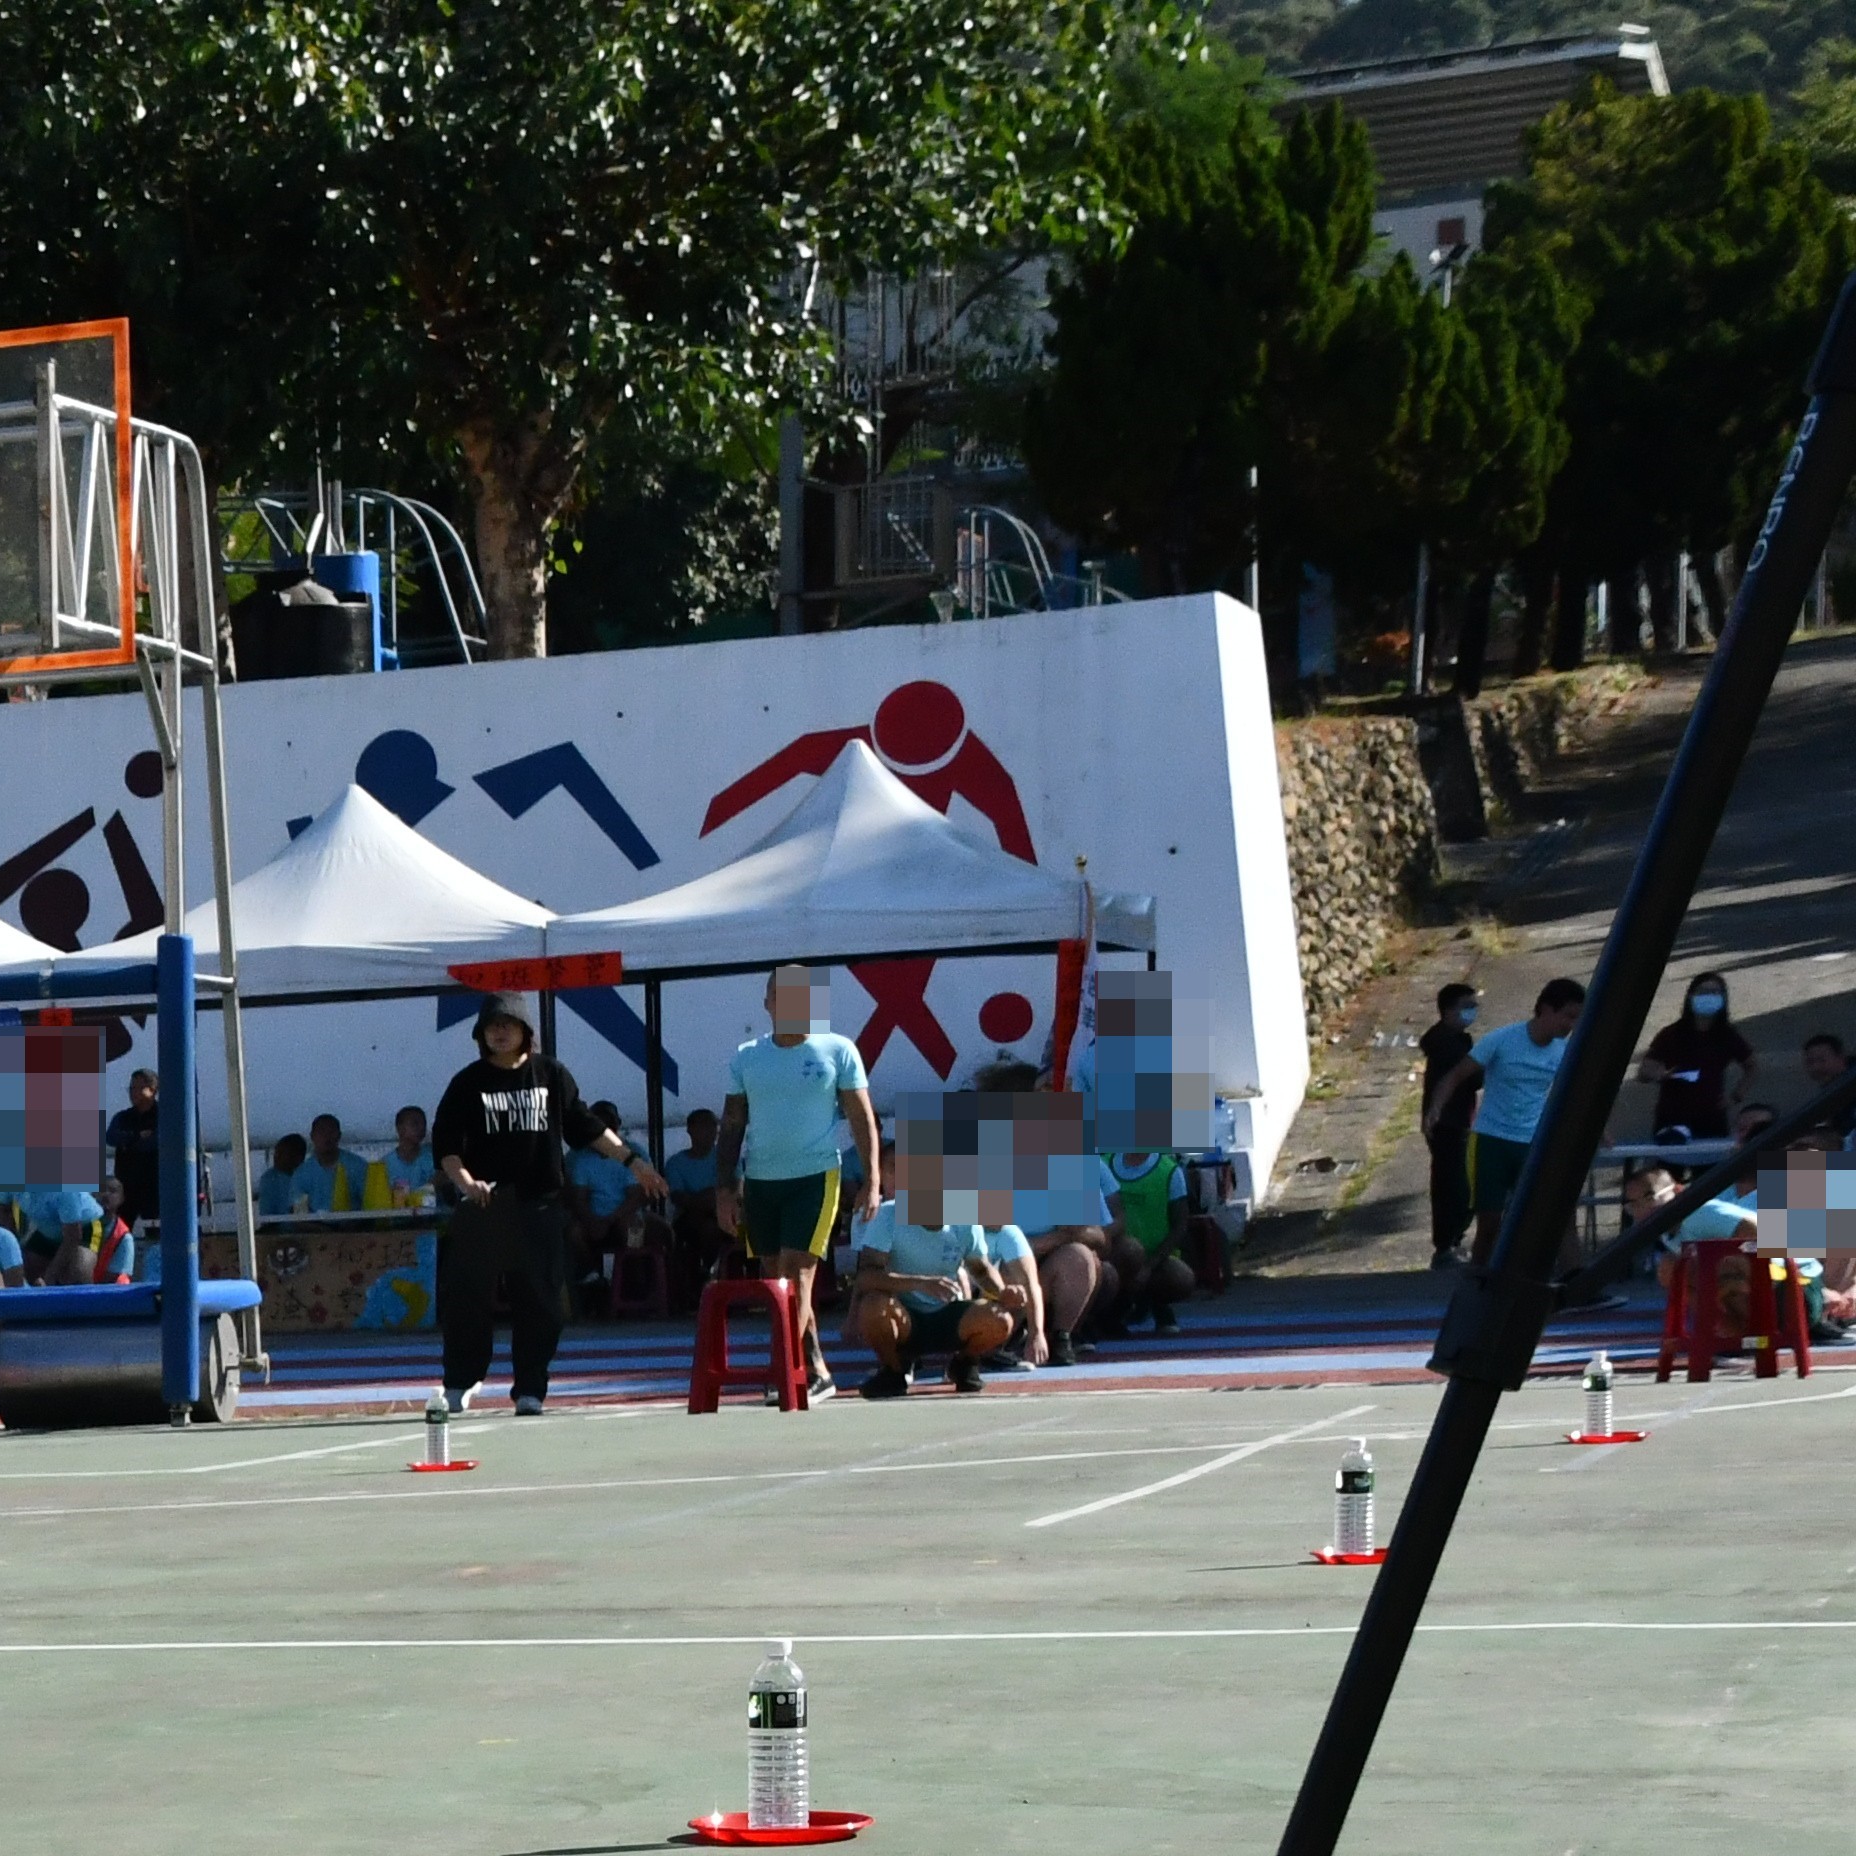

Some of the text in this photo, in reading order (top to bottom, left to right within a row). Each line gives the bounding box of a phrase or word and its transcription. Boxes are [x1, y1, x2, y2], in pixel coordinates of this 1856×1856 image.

[480, 1086, 549, 1112] MIDNIGHT
[484, 1108, 549, 1135] IN PARIS
